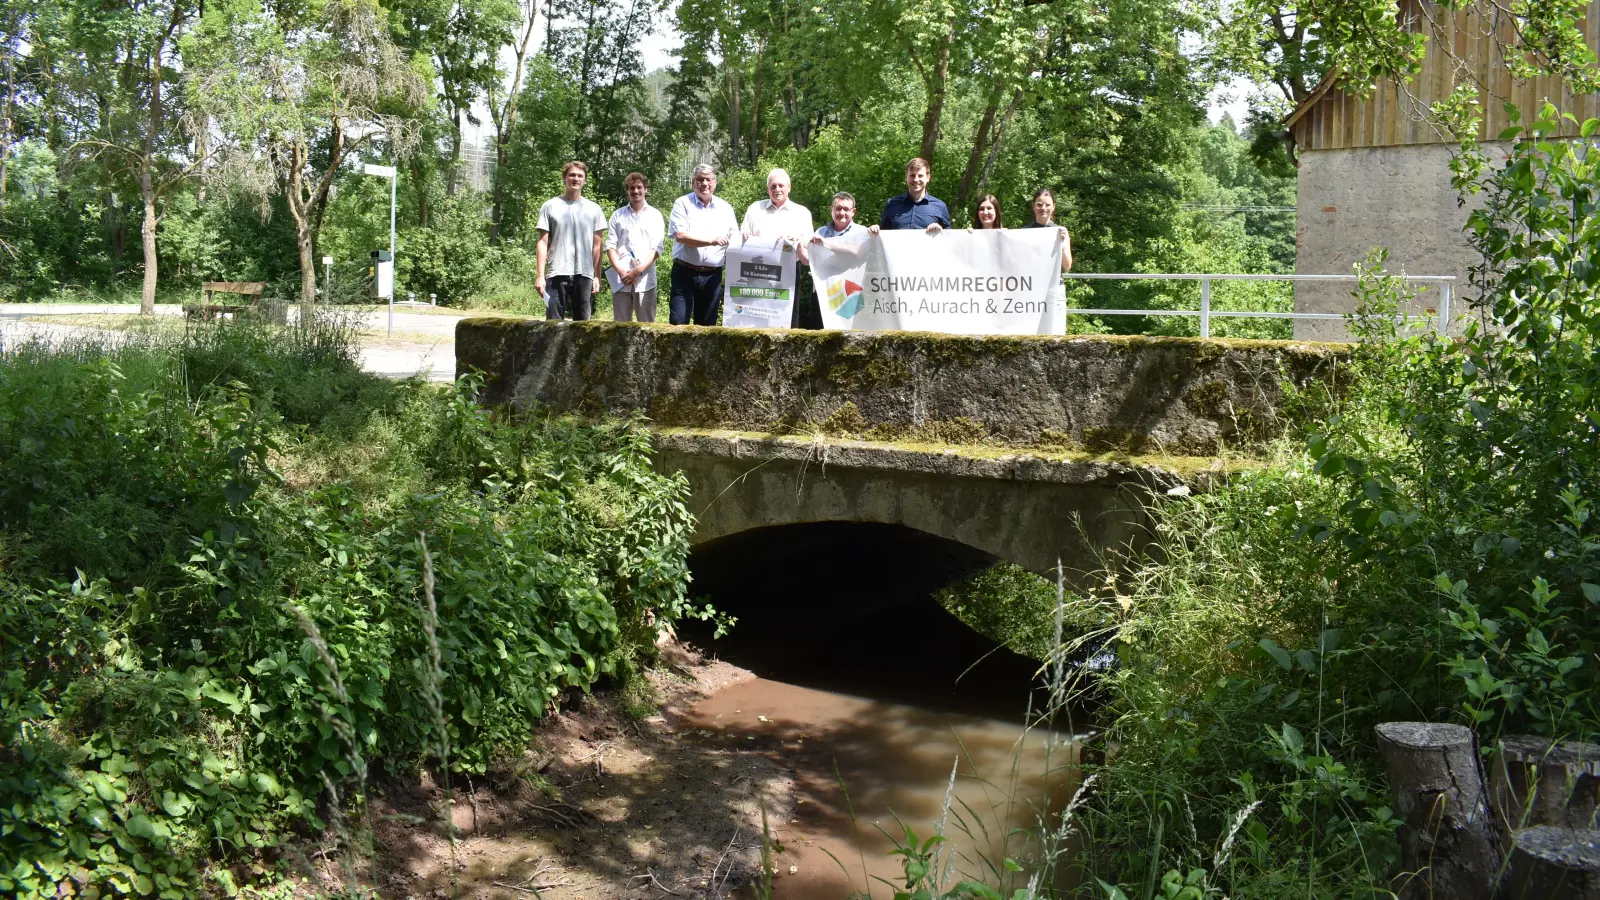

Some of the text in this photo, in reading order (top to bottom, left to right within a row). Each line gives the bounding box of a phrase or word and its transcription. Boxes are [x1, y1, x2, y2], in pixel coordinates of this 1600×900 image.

[739, 288, 780, 298] 180.000 Euro
[870, 276, 1032, 293] SCHWAMMREGION
[873, 296, 1047, 316] Aisch, Aurach & Zenn
